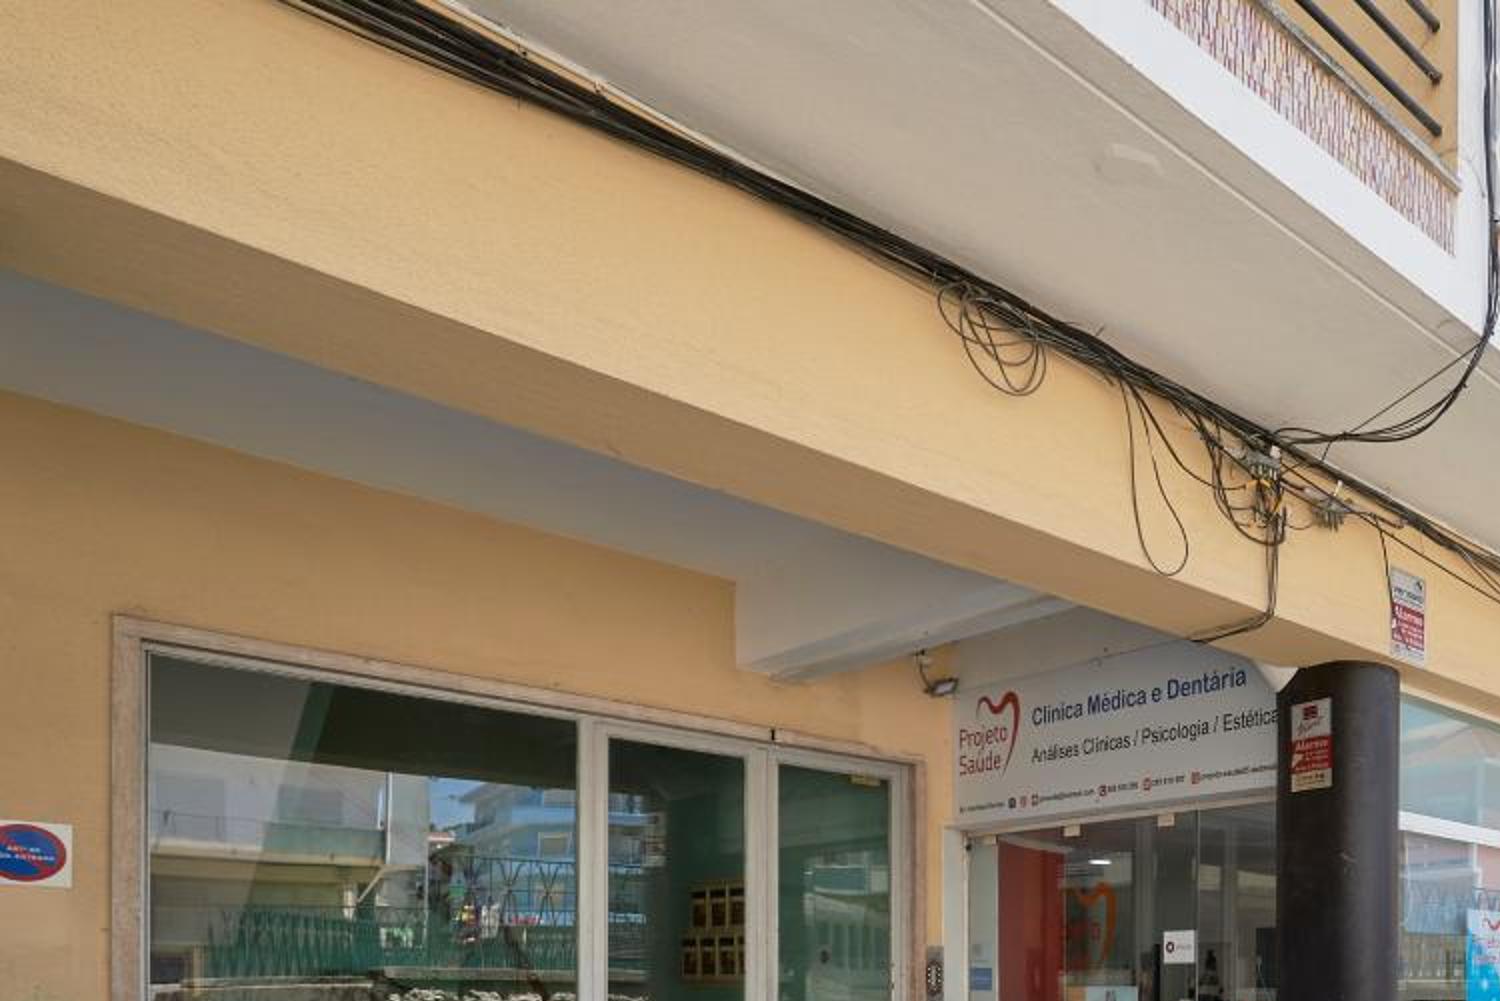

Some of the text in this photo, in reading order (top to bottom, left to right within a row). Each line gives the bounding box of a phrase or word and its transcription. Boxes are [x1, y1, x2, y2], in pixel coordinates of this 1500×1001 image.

[1087, 690, 1147, 715] Médica
[1151, 687, 1162, 702] e
[1167, 666, 1247, 699] Dentária
[959, 726, 1008, 750] Projeto
[1141, 719, 1210, 745] Psicologia
[1223, 707, 1280, 732] Estética
[959, 749, 1001, 776] Saúde
